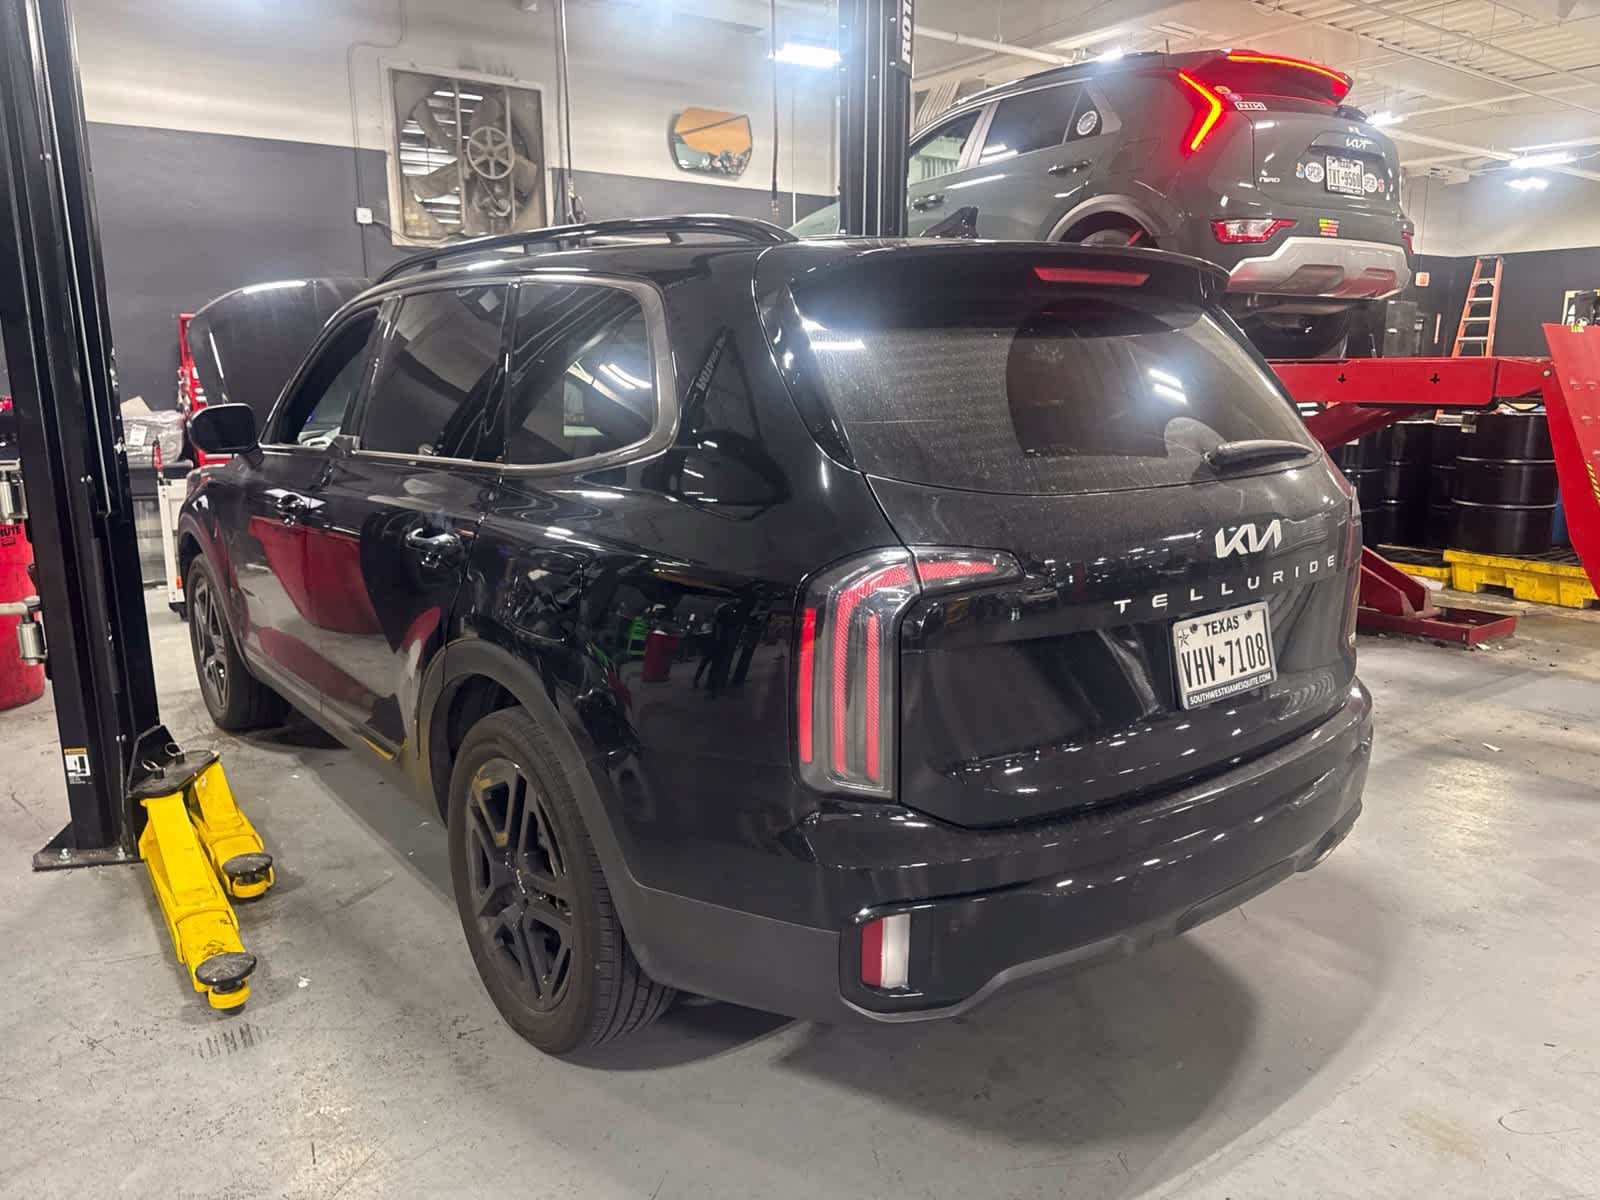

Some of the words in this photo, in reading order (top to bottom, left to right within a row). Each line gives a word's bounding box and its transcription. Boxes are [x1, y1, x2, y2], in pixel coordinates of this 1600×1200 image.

[1215, 519, 1282, 558] KIA
[1114, 555, 1336, 614] TELLURIDE
[1203, 615, 1240, 637] TEXAS
[1181, 645, 1216, 688] VHV
[1224, 632, 1266, 676] 7108
[1190, 672, 1272, 705] SOUTHWESTKIAMESQUITE.COM
